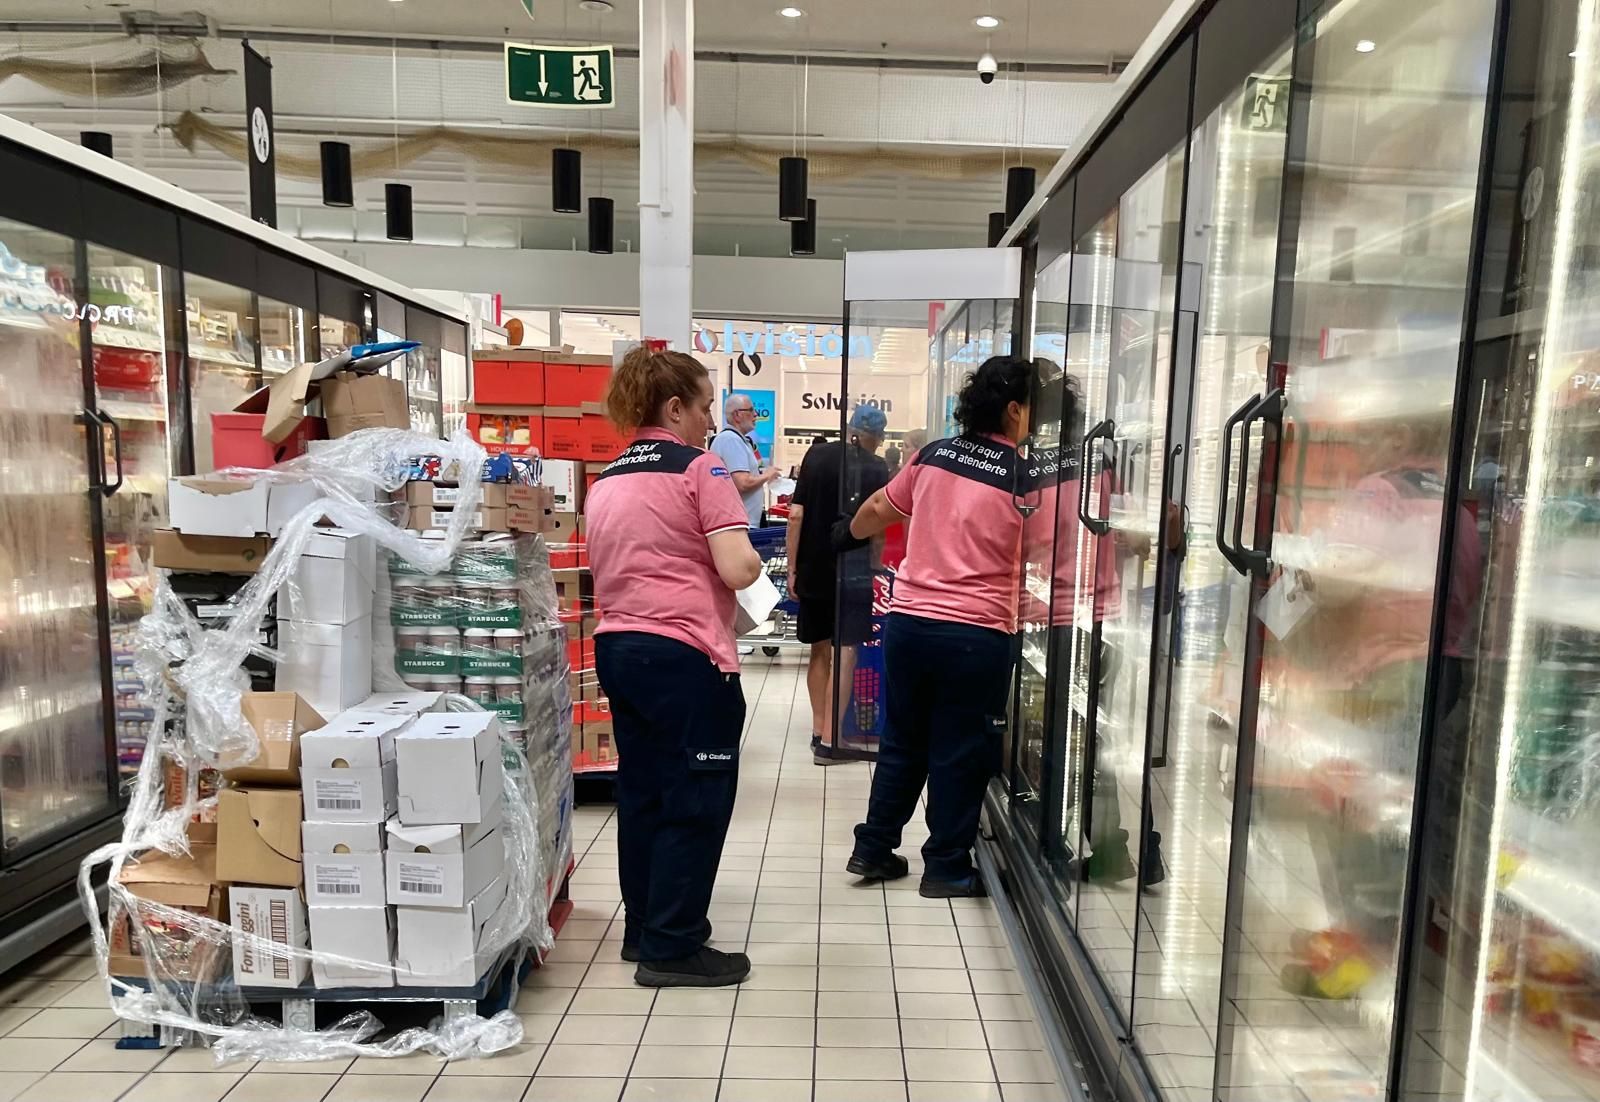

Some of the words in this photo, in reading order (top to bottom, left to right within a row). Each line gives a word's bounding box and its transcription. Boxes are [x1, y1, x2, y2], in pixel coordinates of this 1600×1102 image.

[802, 392, 892, 412] Solvión
[935, 447, 957, 459] para
[957, 452, 1008, 476] atenderte
[951, 437, 977, 453] Estoy
[978, 446, 1004, 460] aquí
[236, 901, 255, 974] Forggini
